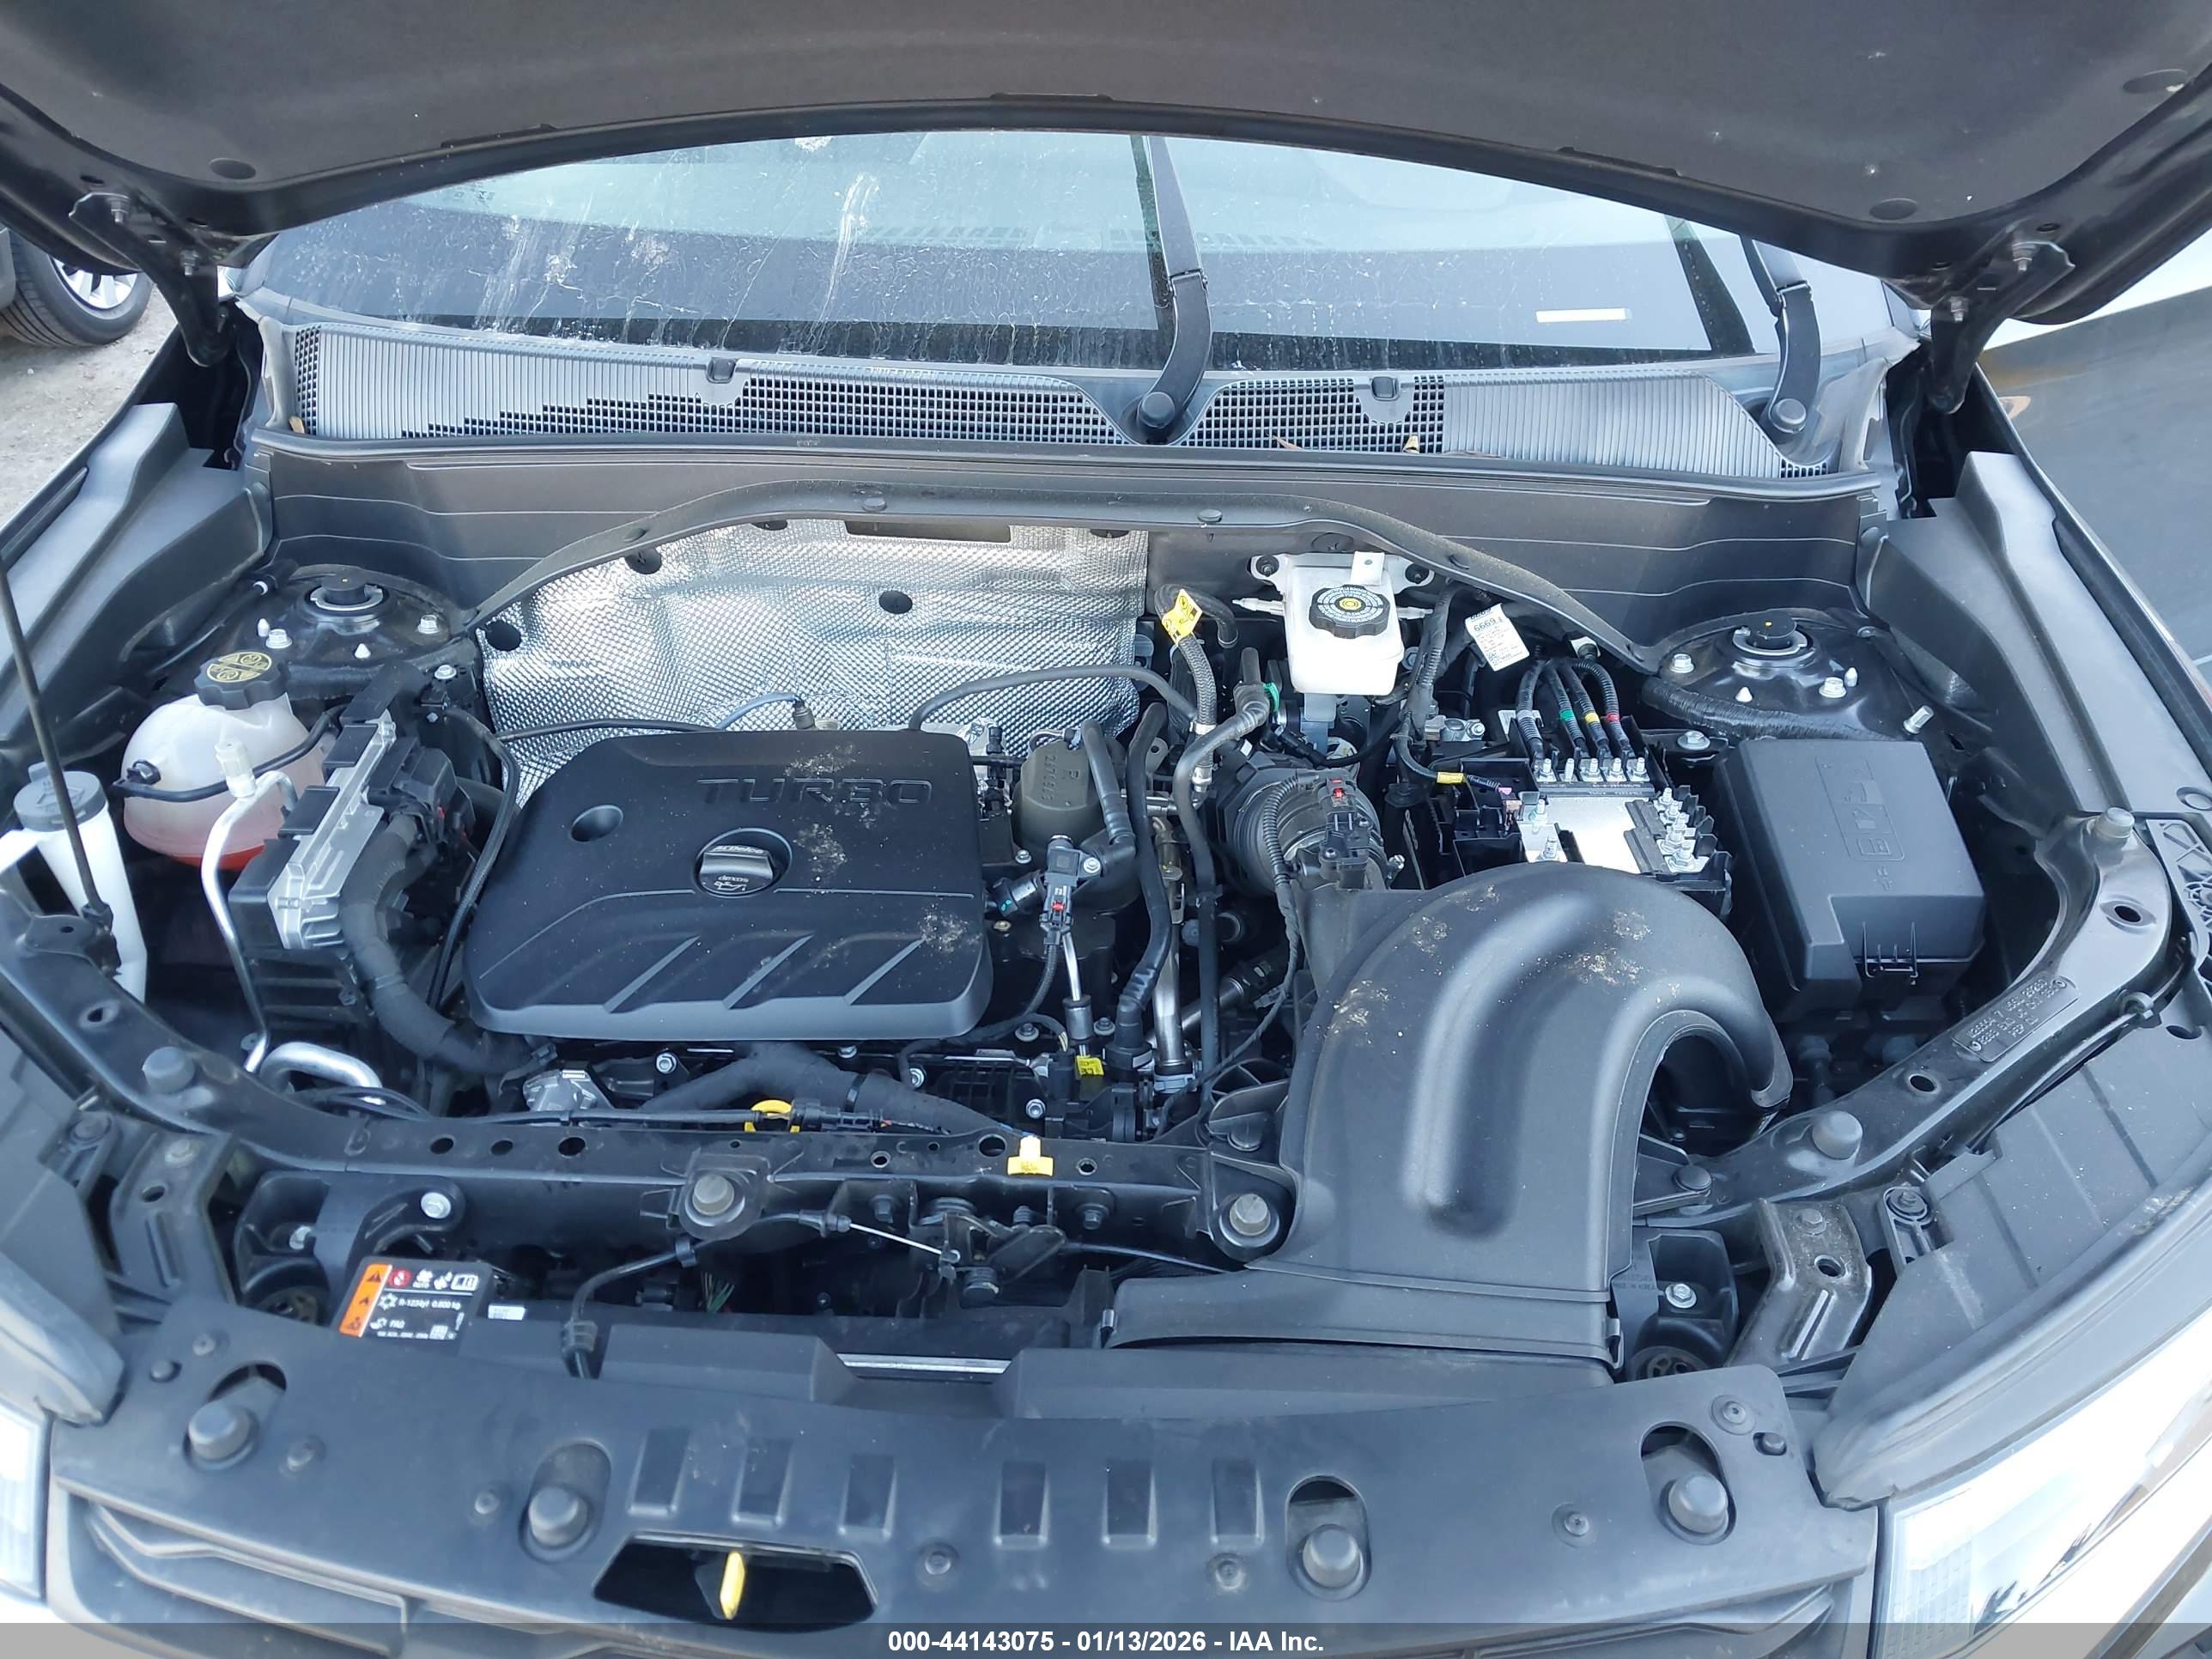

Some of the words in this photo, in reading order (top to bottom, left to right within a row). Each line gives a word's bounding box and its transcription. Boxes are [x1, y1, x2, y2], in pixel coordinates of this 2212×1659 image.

[1474, 617, 1496, 631] 6669
[696, 777, 933, 805] TURBO
[717, 874, 750, 883] dexos
